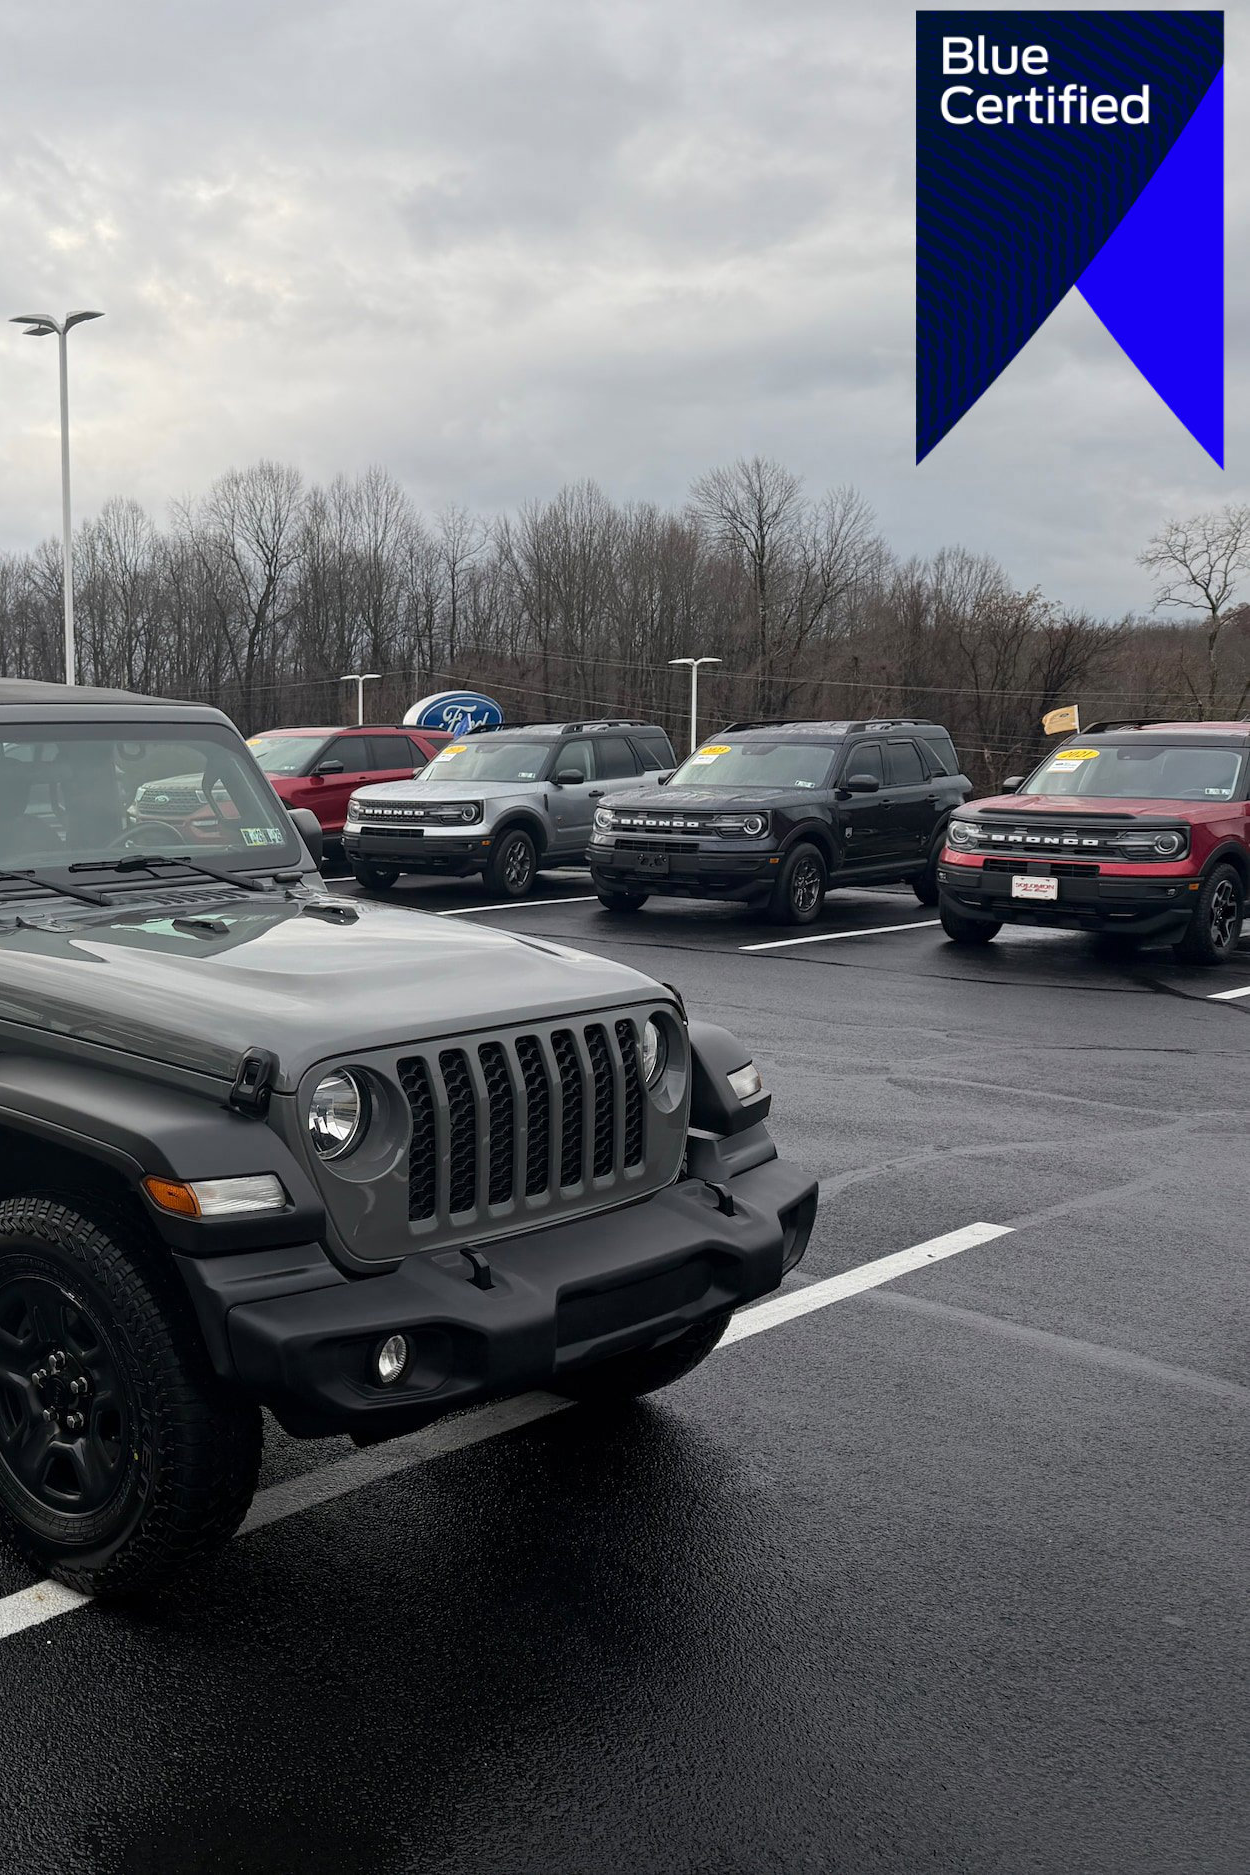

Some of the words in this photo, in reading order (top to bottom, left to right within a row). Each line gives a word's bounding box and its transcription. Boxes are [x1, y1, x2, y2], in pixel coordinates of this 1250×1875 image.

[365, 808, 425, 816] BRONCO
[620, 818, 699, 828] BRONCO
[991, 834, 1099, 847] BRONCO
[1015, 882, 1055, 890] SOLOMON
